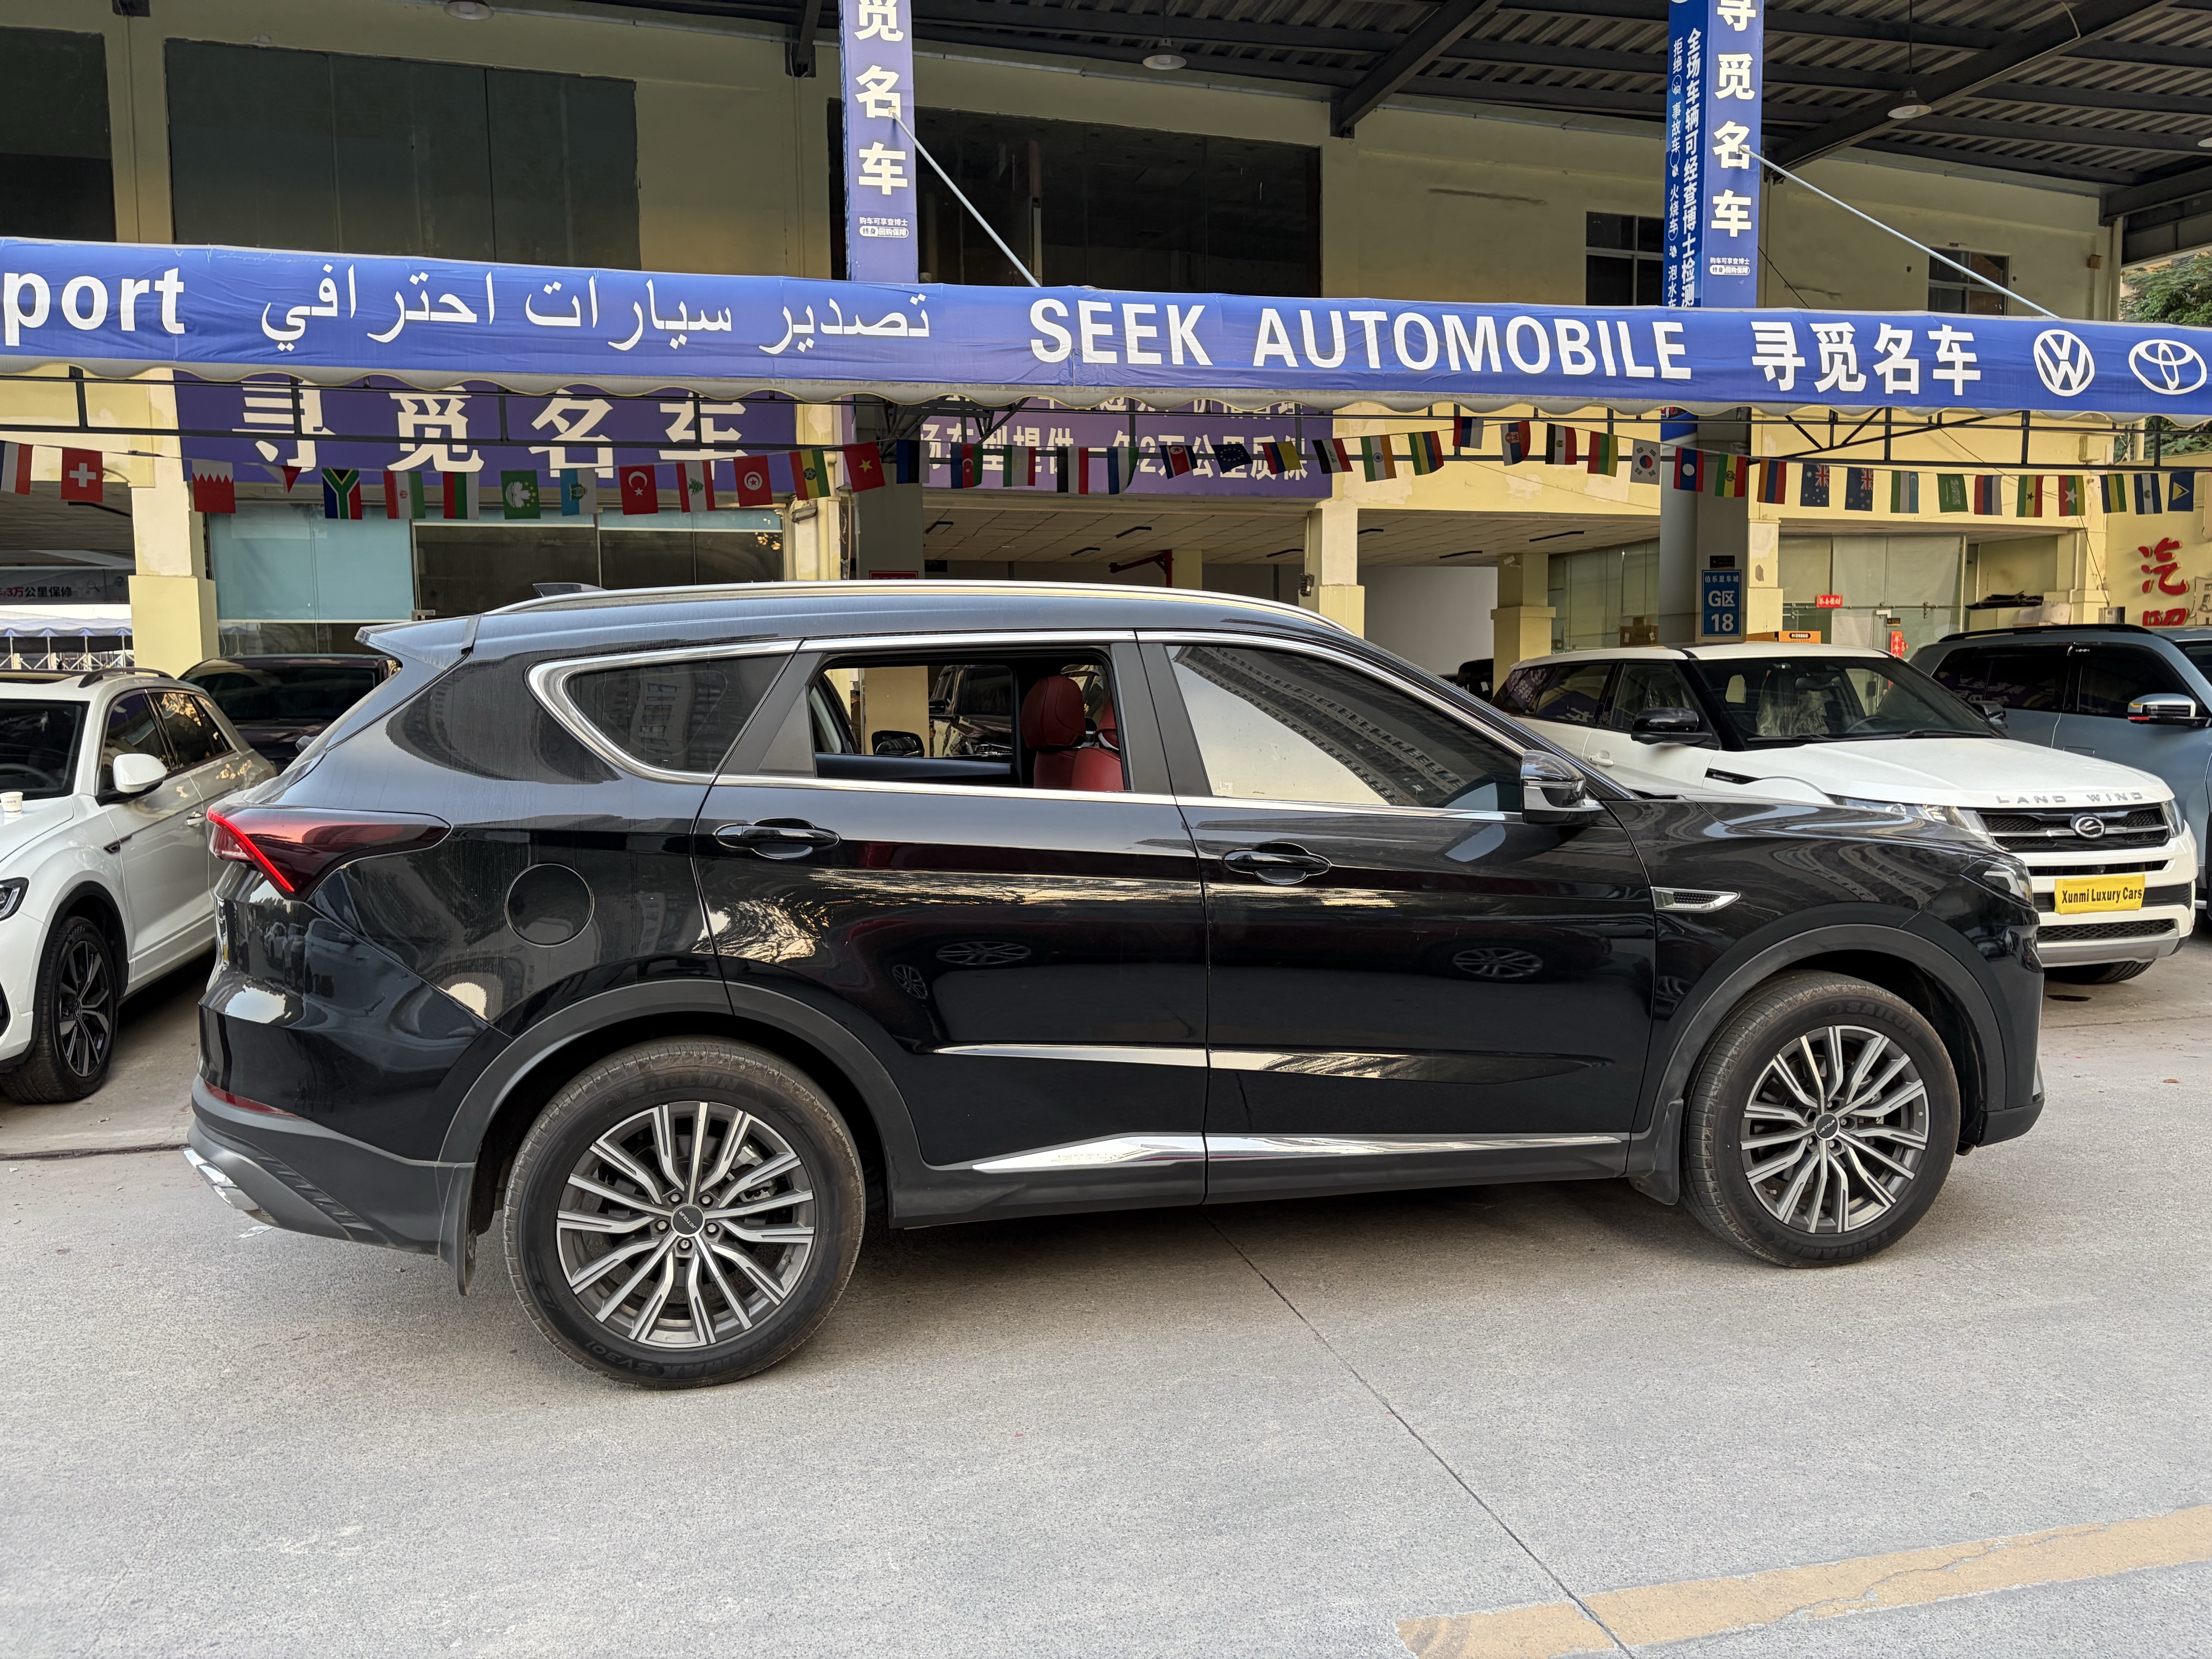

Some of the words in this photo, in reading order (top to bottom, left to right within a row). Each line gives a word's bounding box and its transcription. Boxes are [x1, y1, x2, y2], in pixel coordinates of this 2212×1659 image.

[1673, 36, 1683, 74] 拒绝
[1671, 101, 1681, 153] 事故车
[1681, 27, 1702, 307] 全场车辆可经查博士检测
[1669, 183, 1679, 234] 火烧车
[3, 267, 185, 346] port
[261, 264, 495, 352] احترافي
[525, 276, 732, 351] سيارات
[759, 292, 929, 355] تصدير
[1029, 298, 1214, 366] SEEK
[1253, 308, 1692, 380] AUTOMOBILE
[1750, 321, 1981, 396] 寻觅名车
[1708, 590, 1735, 607] G区
[1711, 613, 1734, 632] 18
[1996, 795, 2066, 804] LAND
[2086, 792, 2143, 802] WIND
[2061, 888, 2090, 904] Xunmi
[2091, 888, 2121, 904] Luxury
[2123, 886, 2142, 900] Cars
[1846, 1001, 1922, 1039] SAILUN
[678, 1210, 697, 1230] JETOUR
